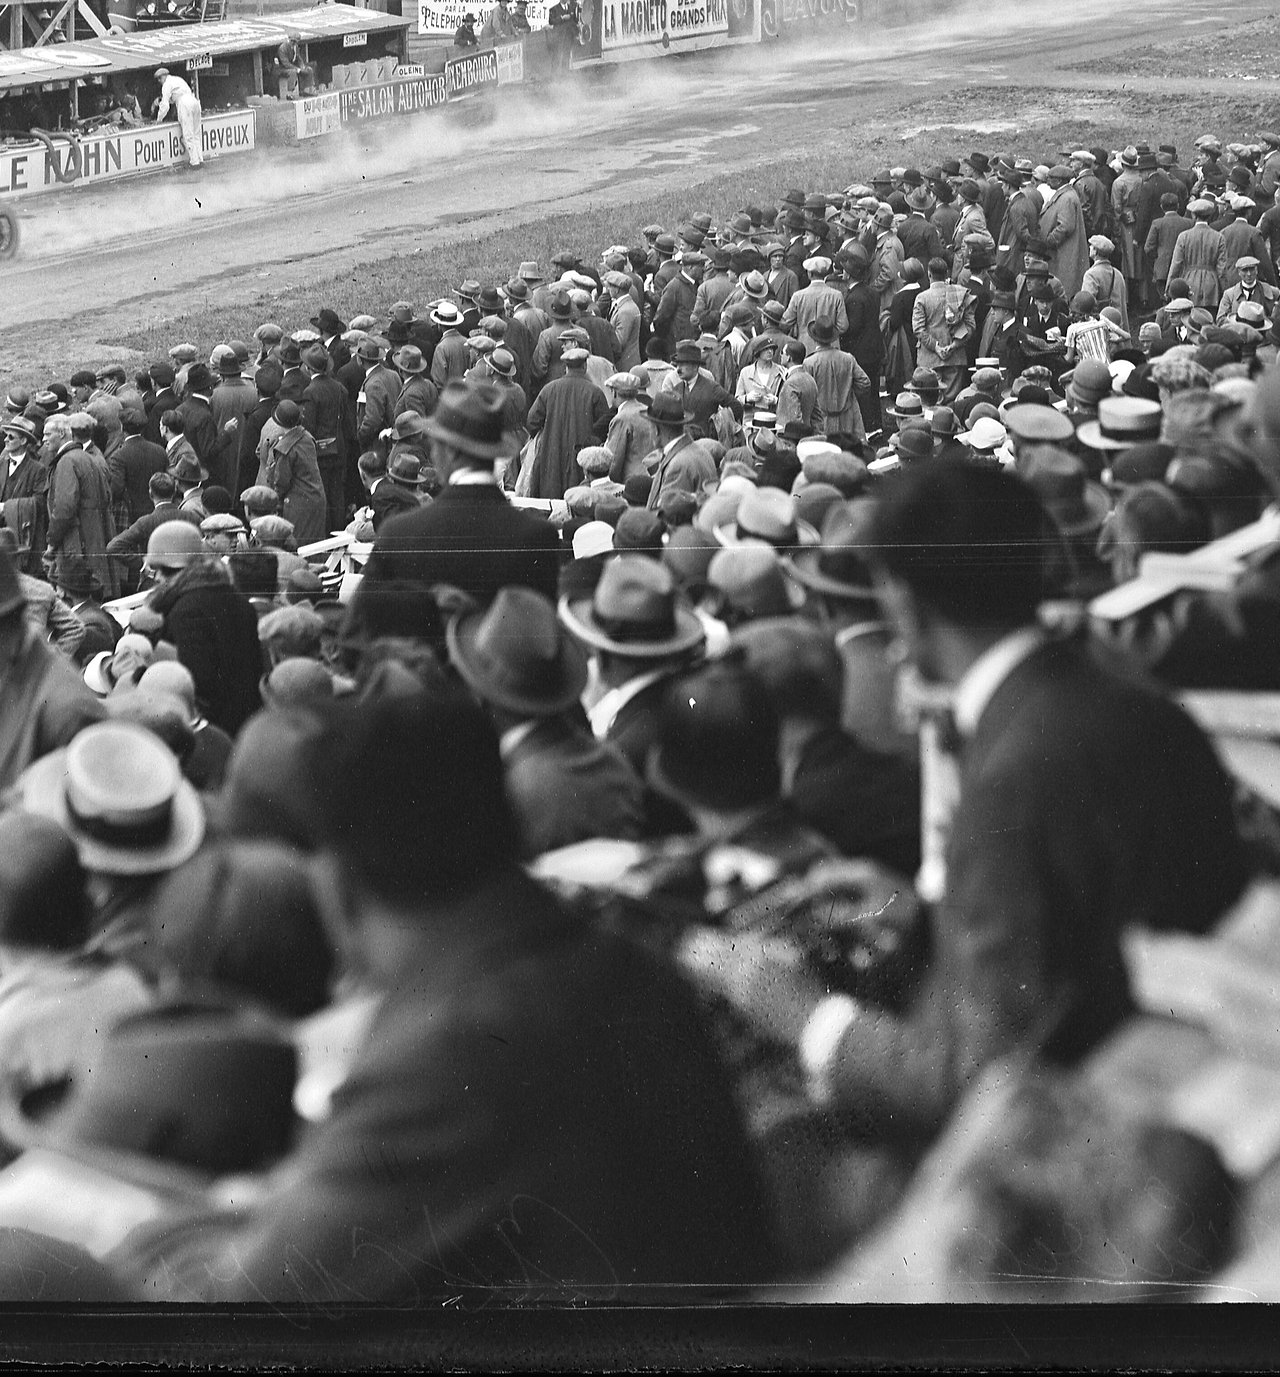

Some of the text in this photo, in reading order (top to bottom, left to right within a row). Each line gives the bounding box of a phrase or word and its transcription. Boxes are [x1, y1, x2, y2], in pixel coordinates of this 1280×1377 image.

[421, 6, 465, 29] TELEPHO
[604, 4, 617, 38] LA
[670, 7, 705, 27] GRANDS
[399, 66, 423, 76] OLEINE
[450, 53, 497, 91] XEMBOURG
[357, 86, 395, 118] SALON
[398, 77, 447, 112] AUTOMOB
[134, 137, 165, 166] Pour
[169, 132, 186, 159] les
[201, 122, 250, 153] heveux
